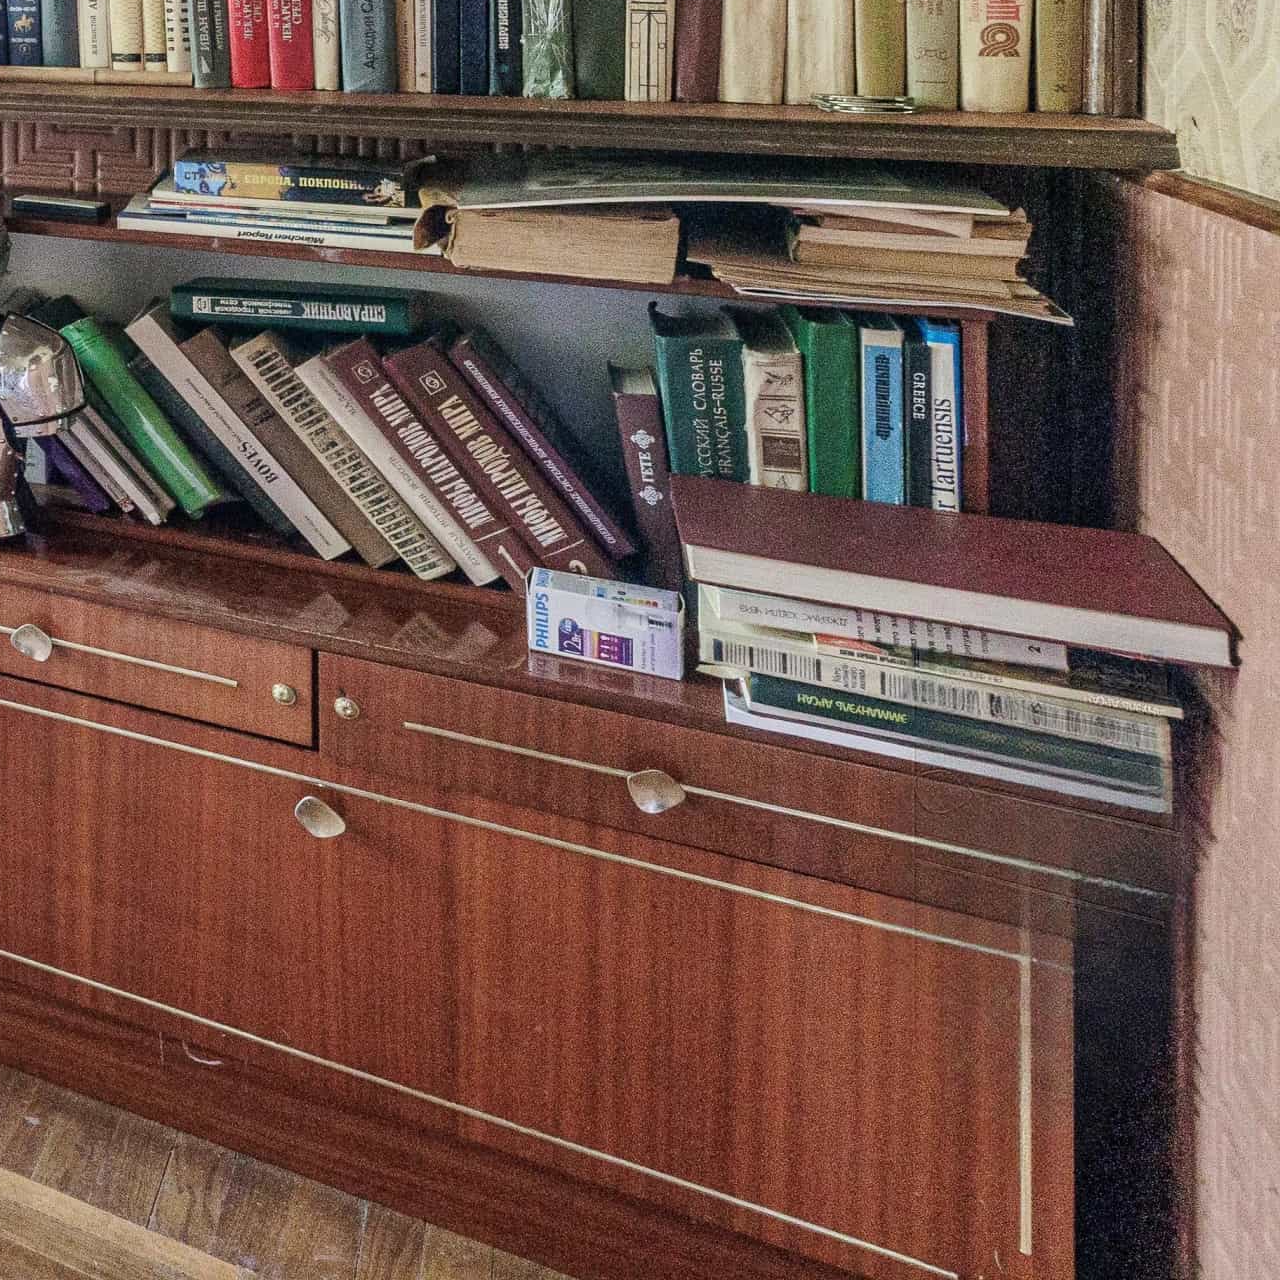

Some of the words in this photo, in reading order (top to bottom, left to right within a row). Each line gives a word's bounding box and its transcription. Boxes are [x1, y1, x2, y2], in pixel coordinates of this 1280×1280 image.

[197, 16, 211, 52] ИВАН
[237, 229, 275, 242] Report
[273, 231, 326, 246] München
[301, 300, 387, 323] СПРАВОЧНИК
[367, 379, 413, 430] МИРА
[689, 347, 708, 411] СЛОВАРЬ
[912, 372, 927, 421] GREECE
[435, 390, 483, 444] МИРА
[710, 358, 736, 475] FRANÇAIS-RUSSE
[234, 436, 282, 487] BOVES
[395, 417, 457, 489] НАРОДОВ
[463, 427, 534, 507] НАРОДОВ
[637, 451, 655, 483] ГЕТЕ
[693, 418, 716, 479] УССКИЙ
[931, 398, 957, 496] Tartuensis
[439, 472, 493, 533] МИФЫ
[509, 488, 568, 553] МИФЫ
[535, 591, 550, 649] PHILIPS
[797, 692, 835, 711] АРСАН
[834, 699, 909, 724] ЭММАНУЭЛЬ
